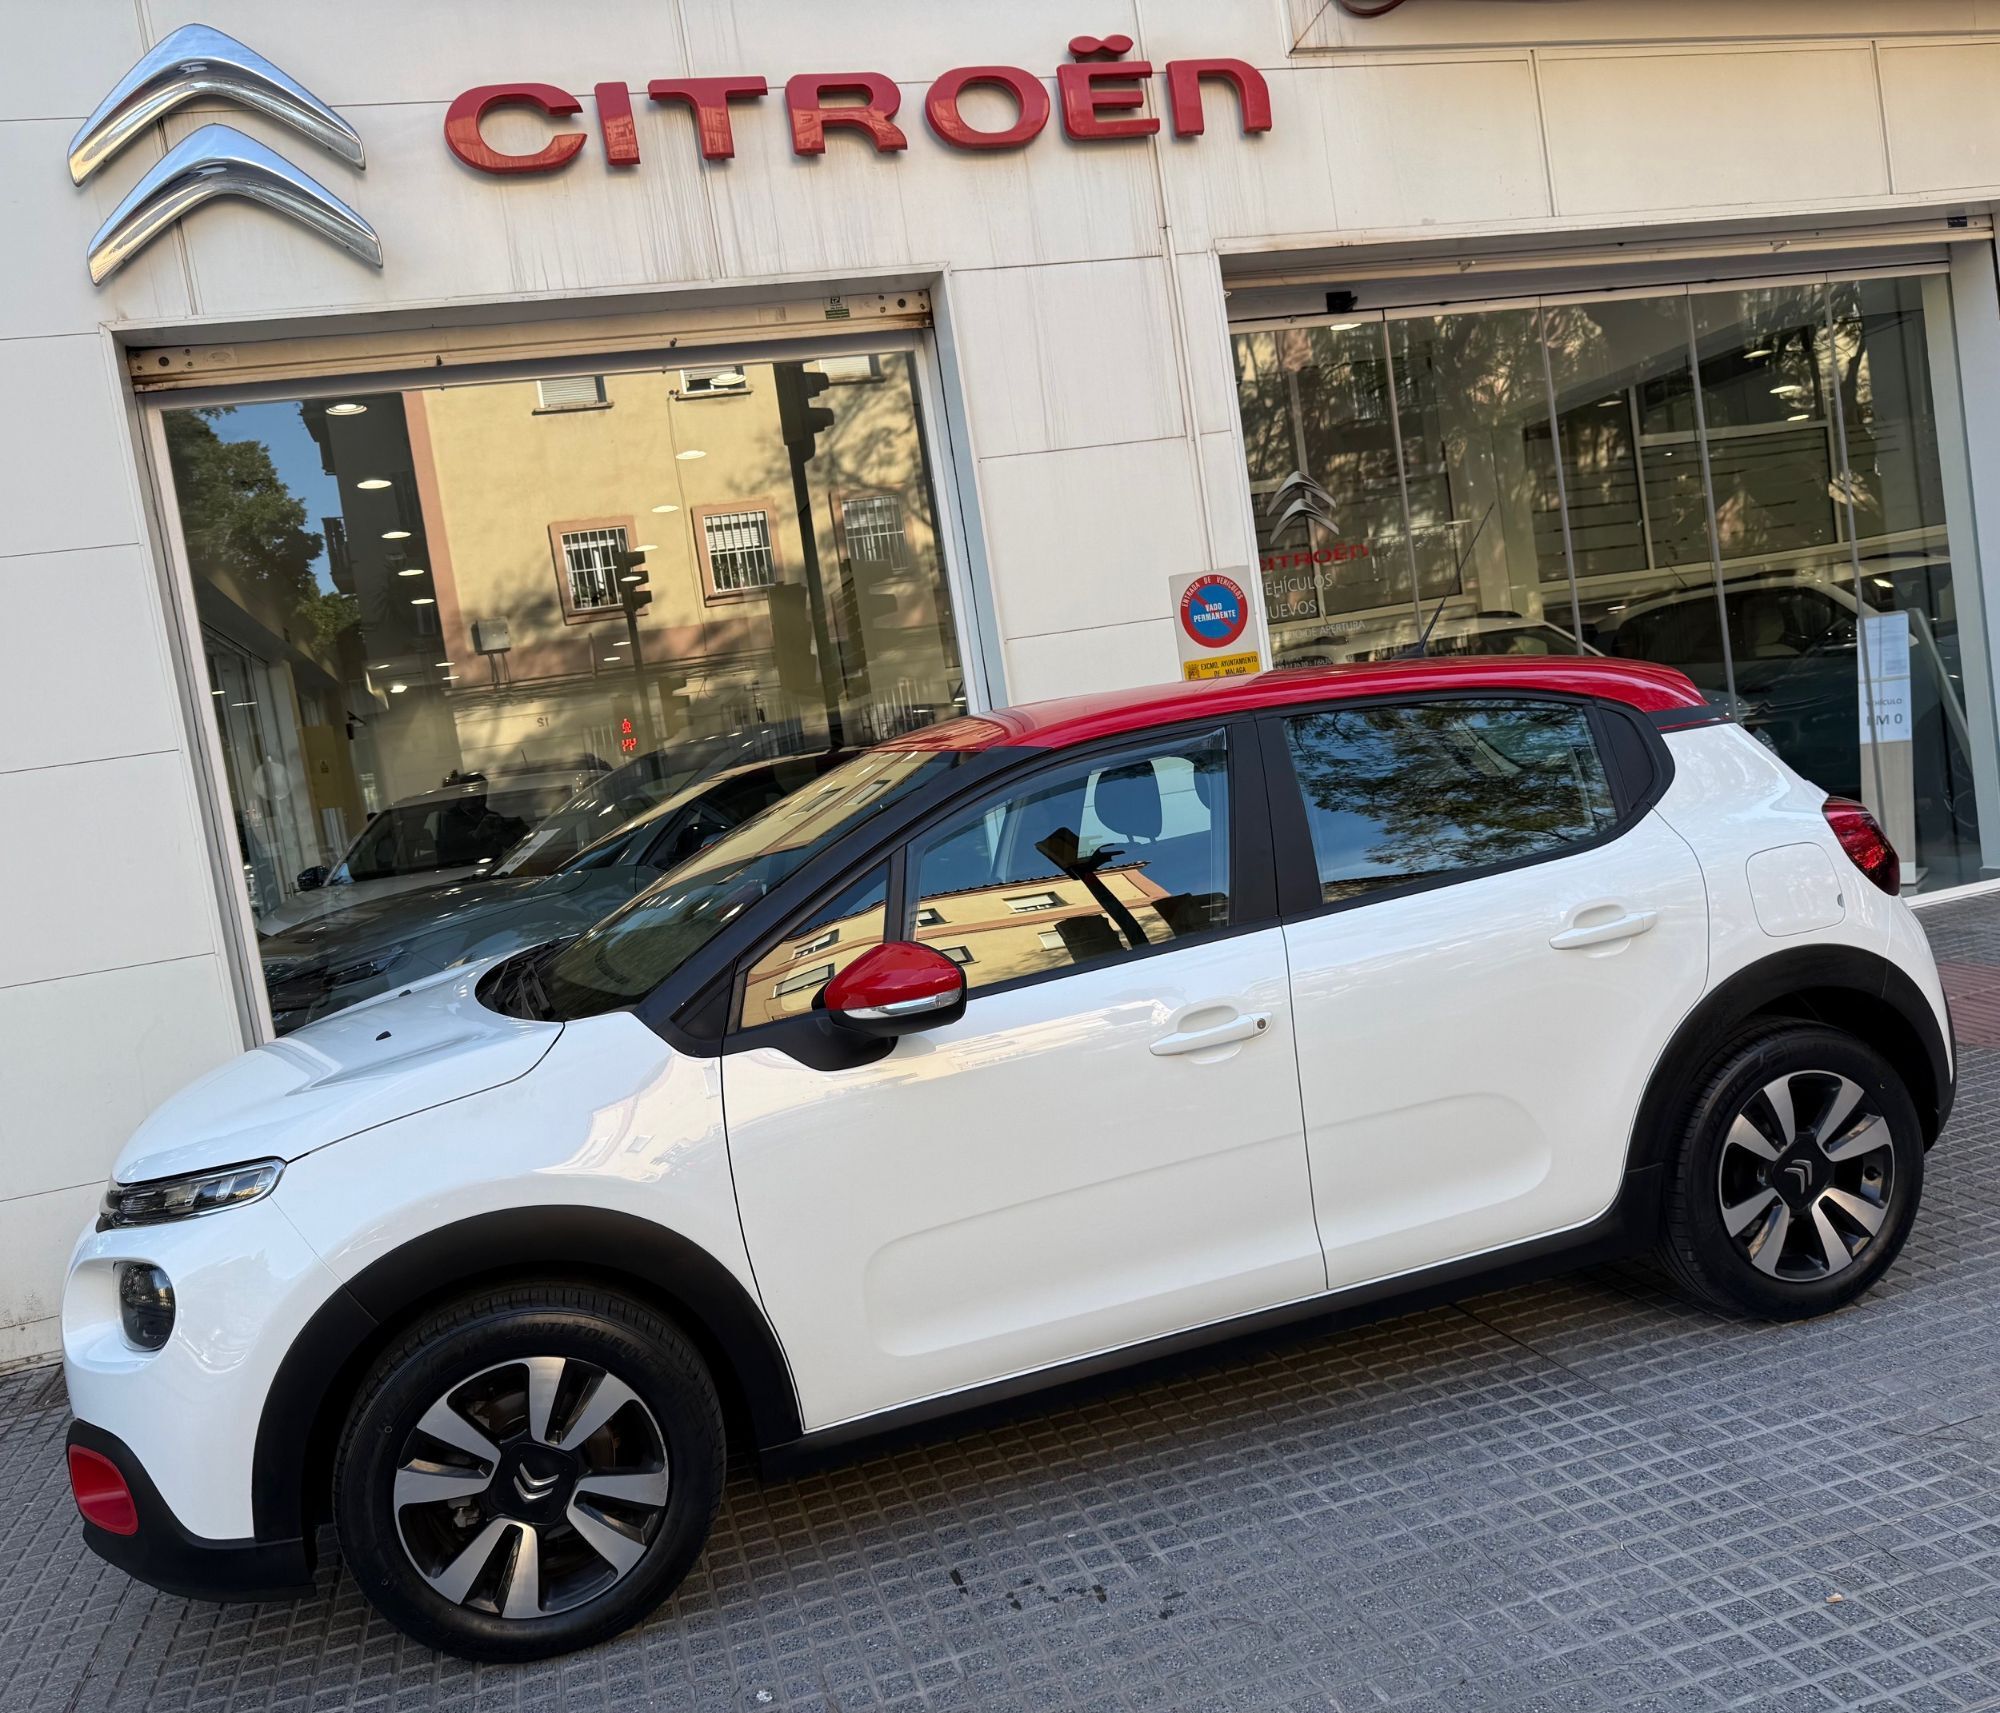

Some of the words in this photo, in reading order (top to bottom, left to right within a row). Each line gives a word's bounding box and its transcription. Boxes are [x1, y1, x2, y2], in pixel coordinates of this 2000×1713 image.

[1182, 581, 1201, 607] ENTRADA
[1203, 576, 1212, 585] DE
[1263, 572, 1333, 596] EHÍCULOS
[1193, 609, 1237, 623] PERMANENTE
[1205, 602, 1223, 612] VADO
[1266, 599, 1318, 620] UEVOS
